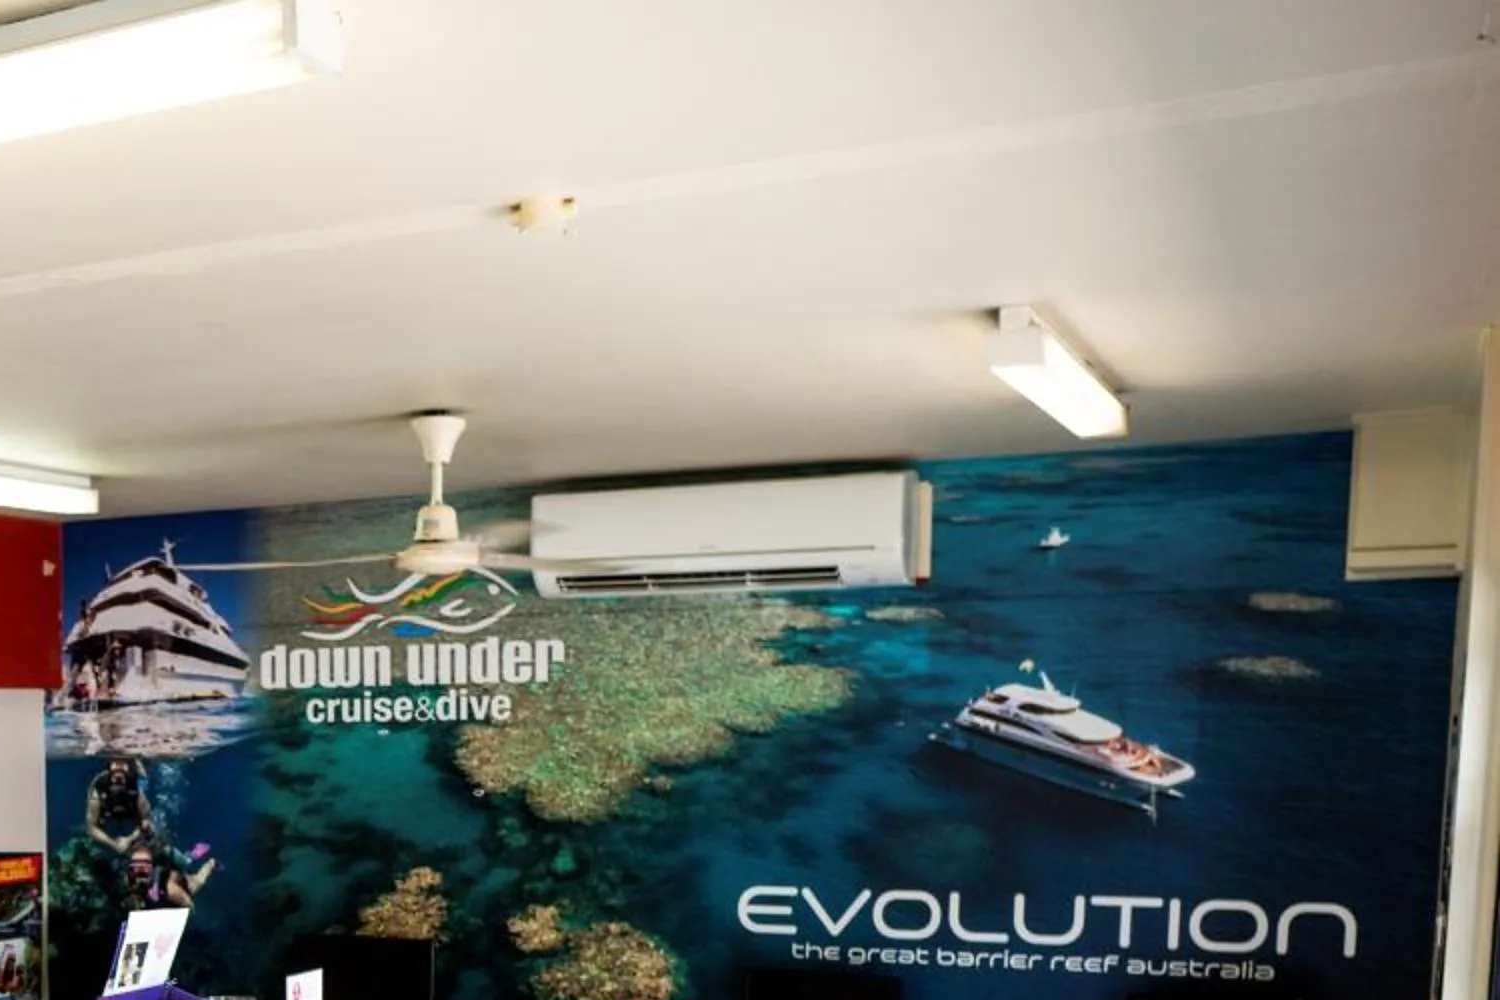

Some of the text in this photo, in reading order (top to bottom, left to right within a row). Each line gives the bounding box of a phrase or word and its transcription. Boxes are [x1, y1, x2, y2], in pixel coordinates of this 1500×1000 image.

[260, 636, 565, 690] down under
[306, 688, 513, 724] cruise&dive
[791, 942, 1276, 982] the great barrier reef australia
